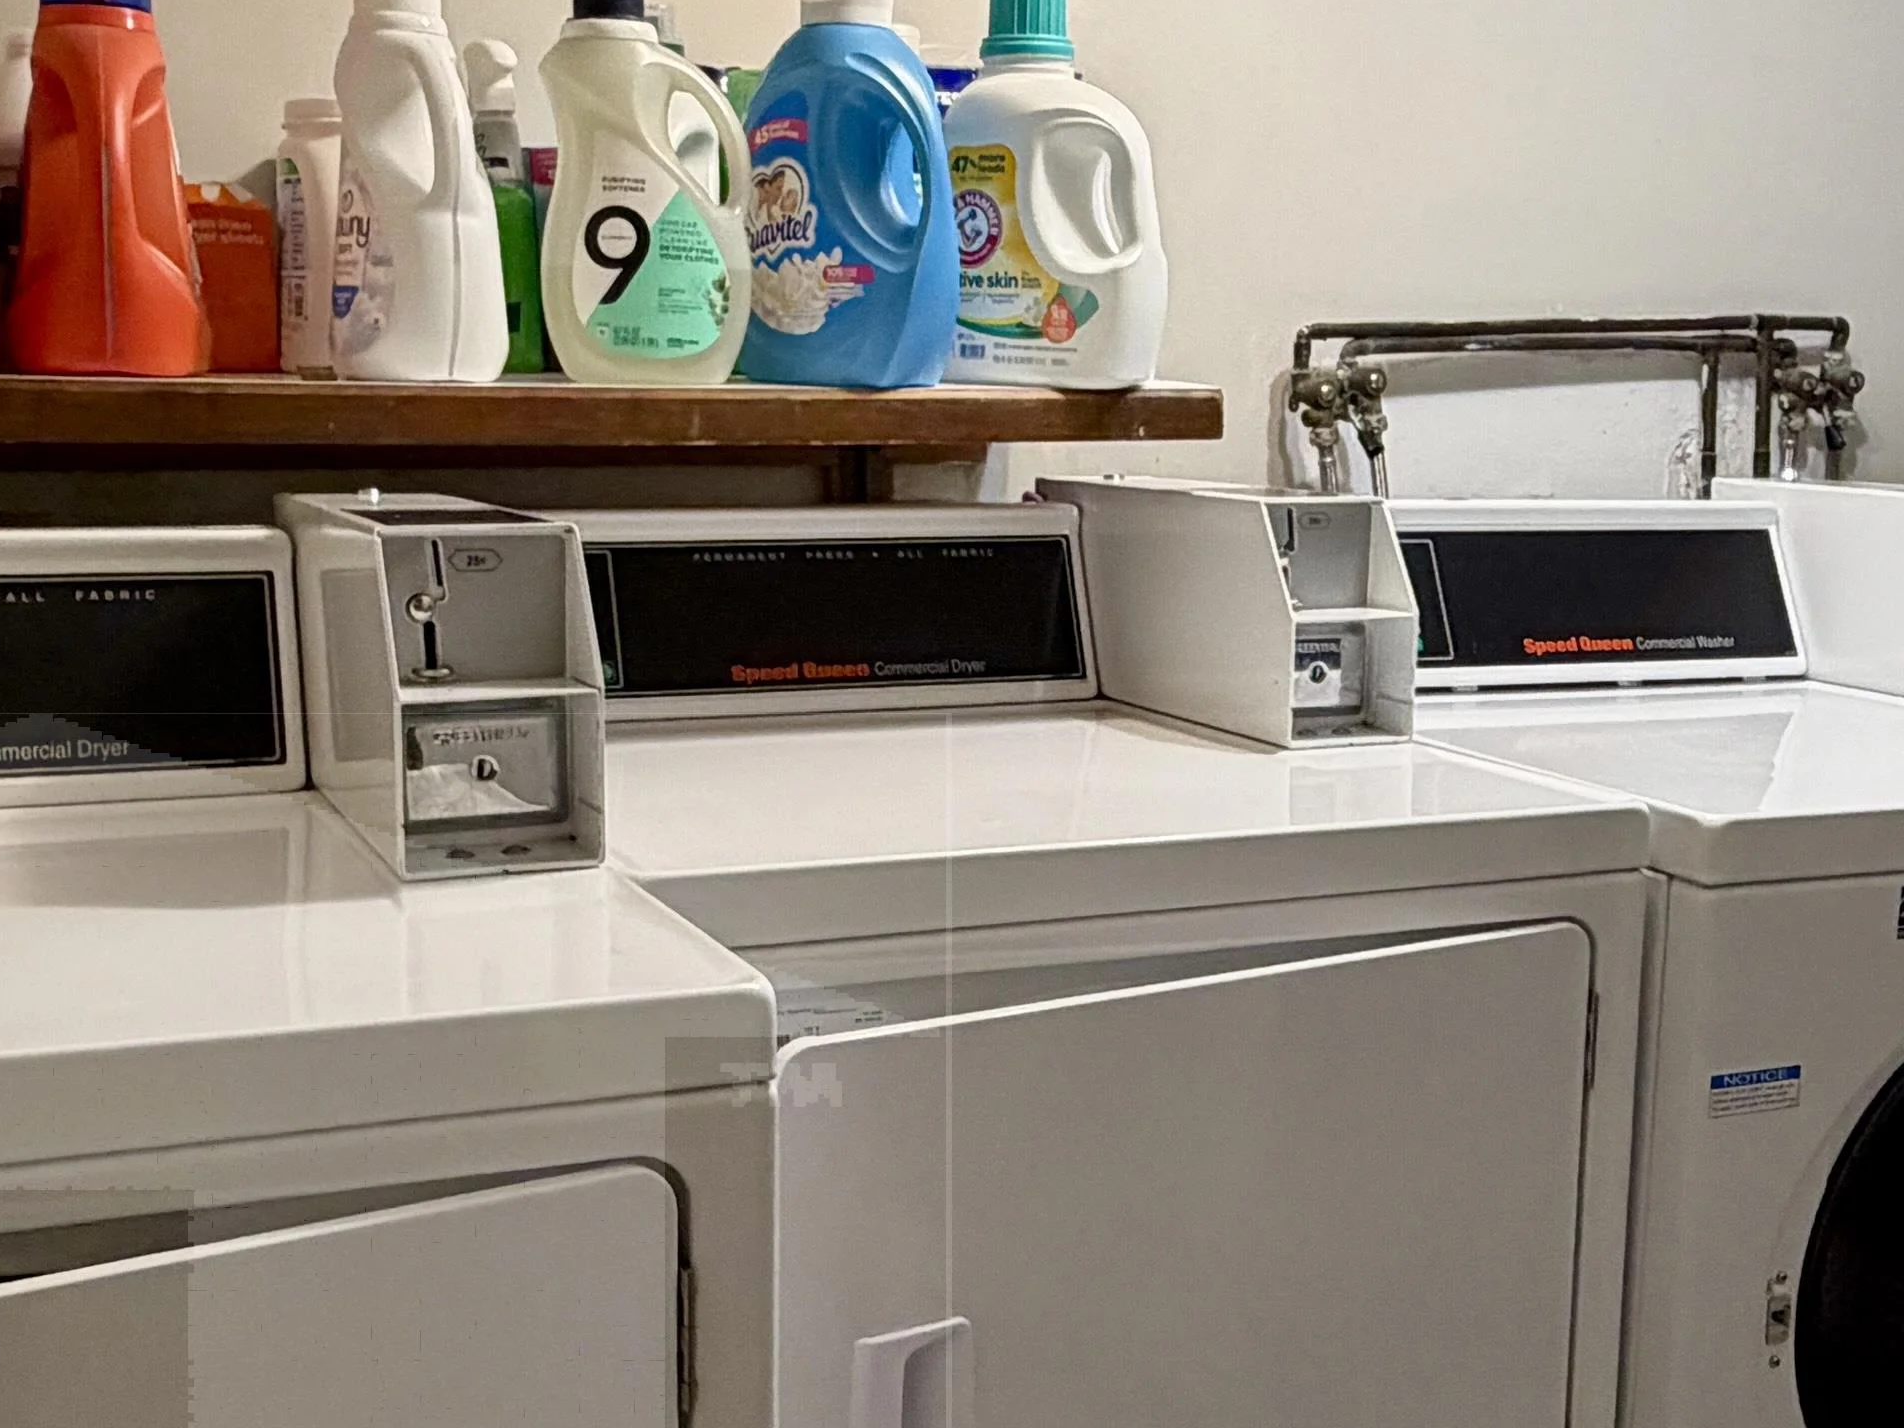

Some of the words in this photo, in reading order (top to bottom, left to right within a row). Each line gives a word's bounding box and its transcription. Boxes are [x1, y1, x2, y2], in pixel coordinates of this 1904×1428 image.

[584, 204, 650, 306] 9
[960, 270, 985, 289] tive
[986, 271, 1019, 288] skin
[4, 591, 45, 604] ALL
[74, 588, 156, 603] FABRIC
[1523, 636, 1579, 657] Speed
[1578, 635, 1635, 652] Queen
[1635, 635, 1696, 650] Commercial
[1696, 634, 1736, 649] Washer
[730, 662, 799, 685] Speed
[802, 660, 870, 679] Queen
[873, 659, 949, 677] Commercial
[950, 658, 987, 675] Dryer
[77, 739, 129, 762] Dryer
[1723, 1068, 1788, 1086] NOTICE
